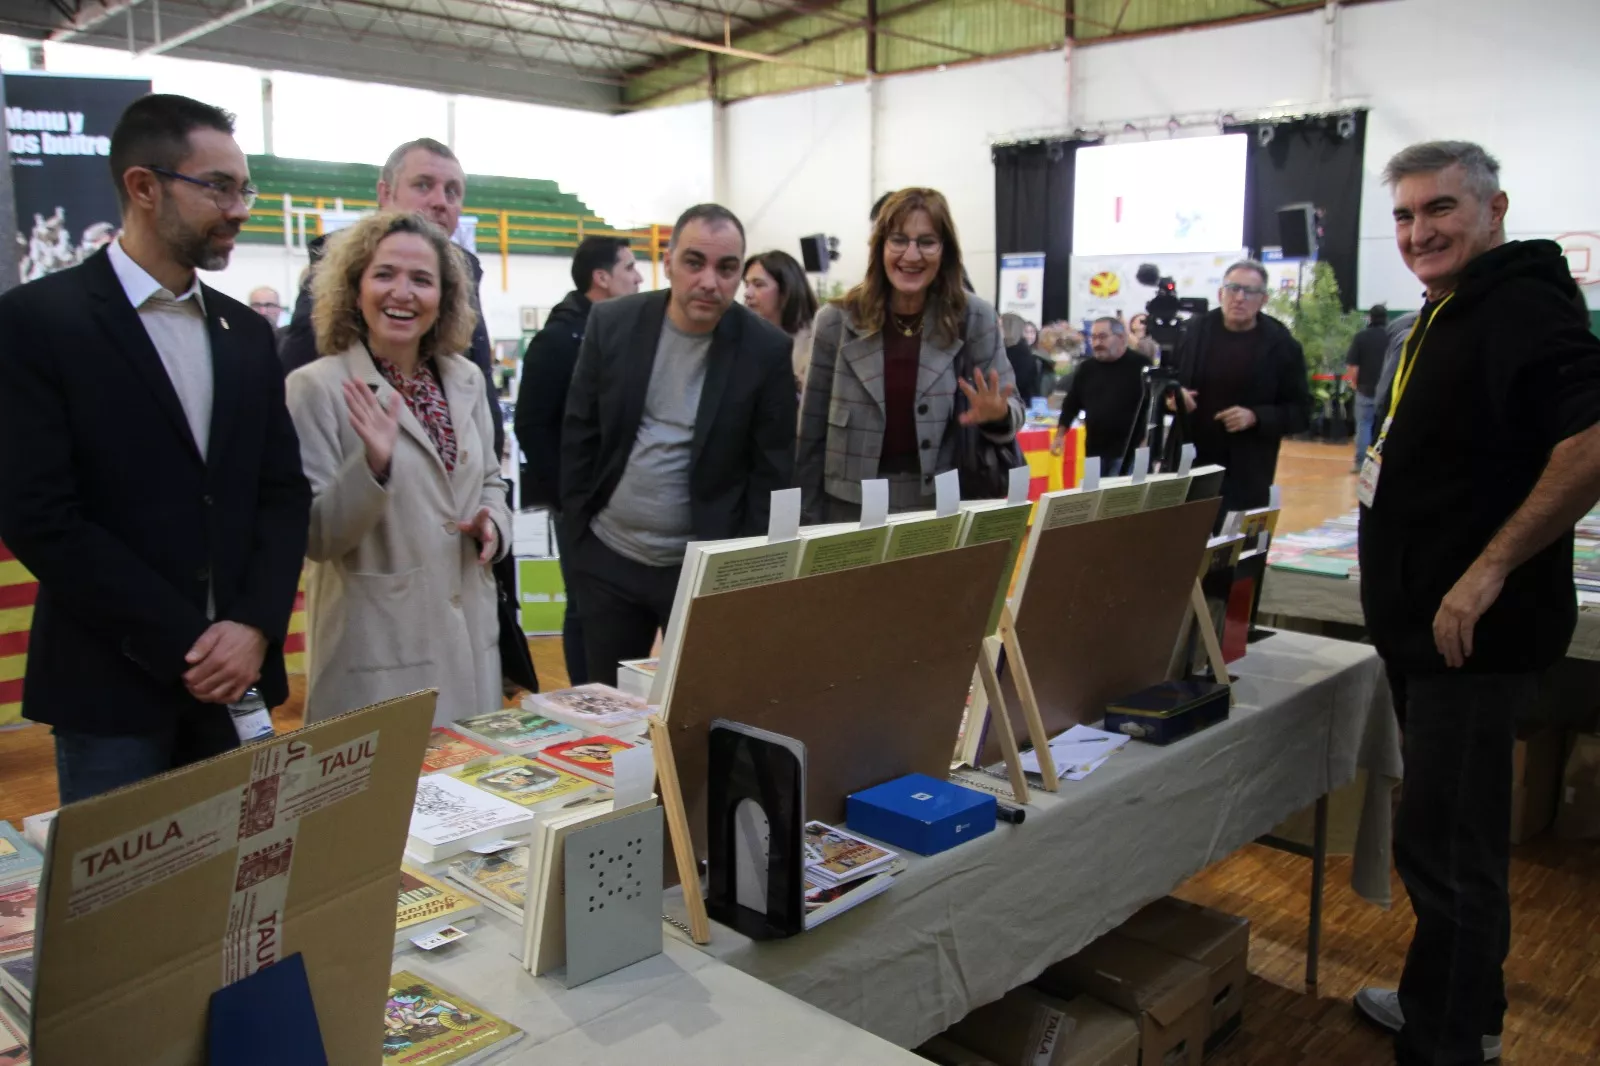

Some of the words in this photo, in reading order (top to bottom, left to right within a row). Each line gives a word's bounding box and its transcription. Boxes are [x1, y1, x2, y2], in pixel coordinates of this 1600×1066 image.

[4, 107, 67, 131] Manu
[69, 111, 84, 135] y
[81, 820, 183, 878] TAULA
[1038, 1016, 1060, 1054] TAULA
